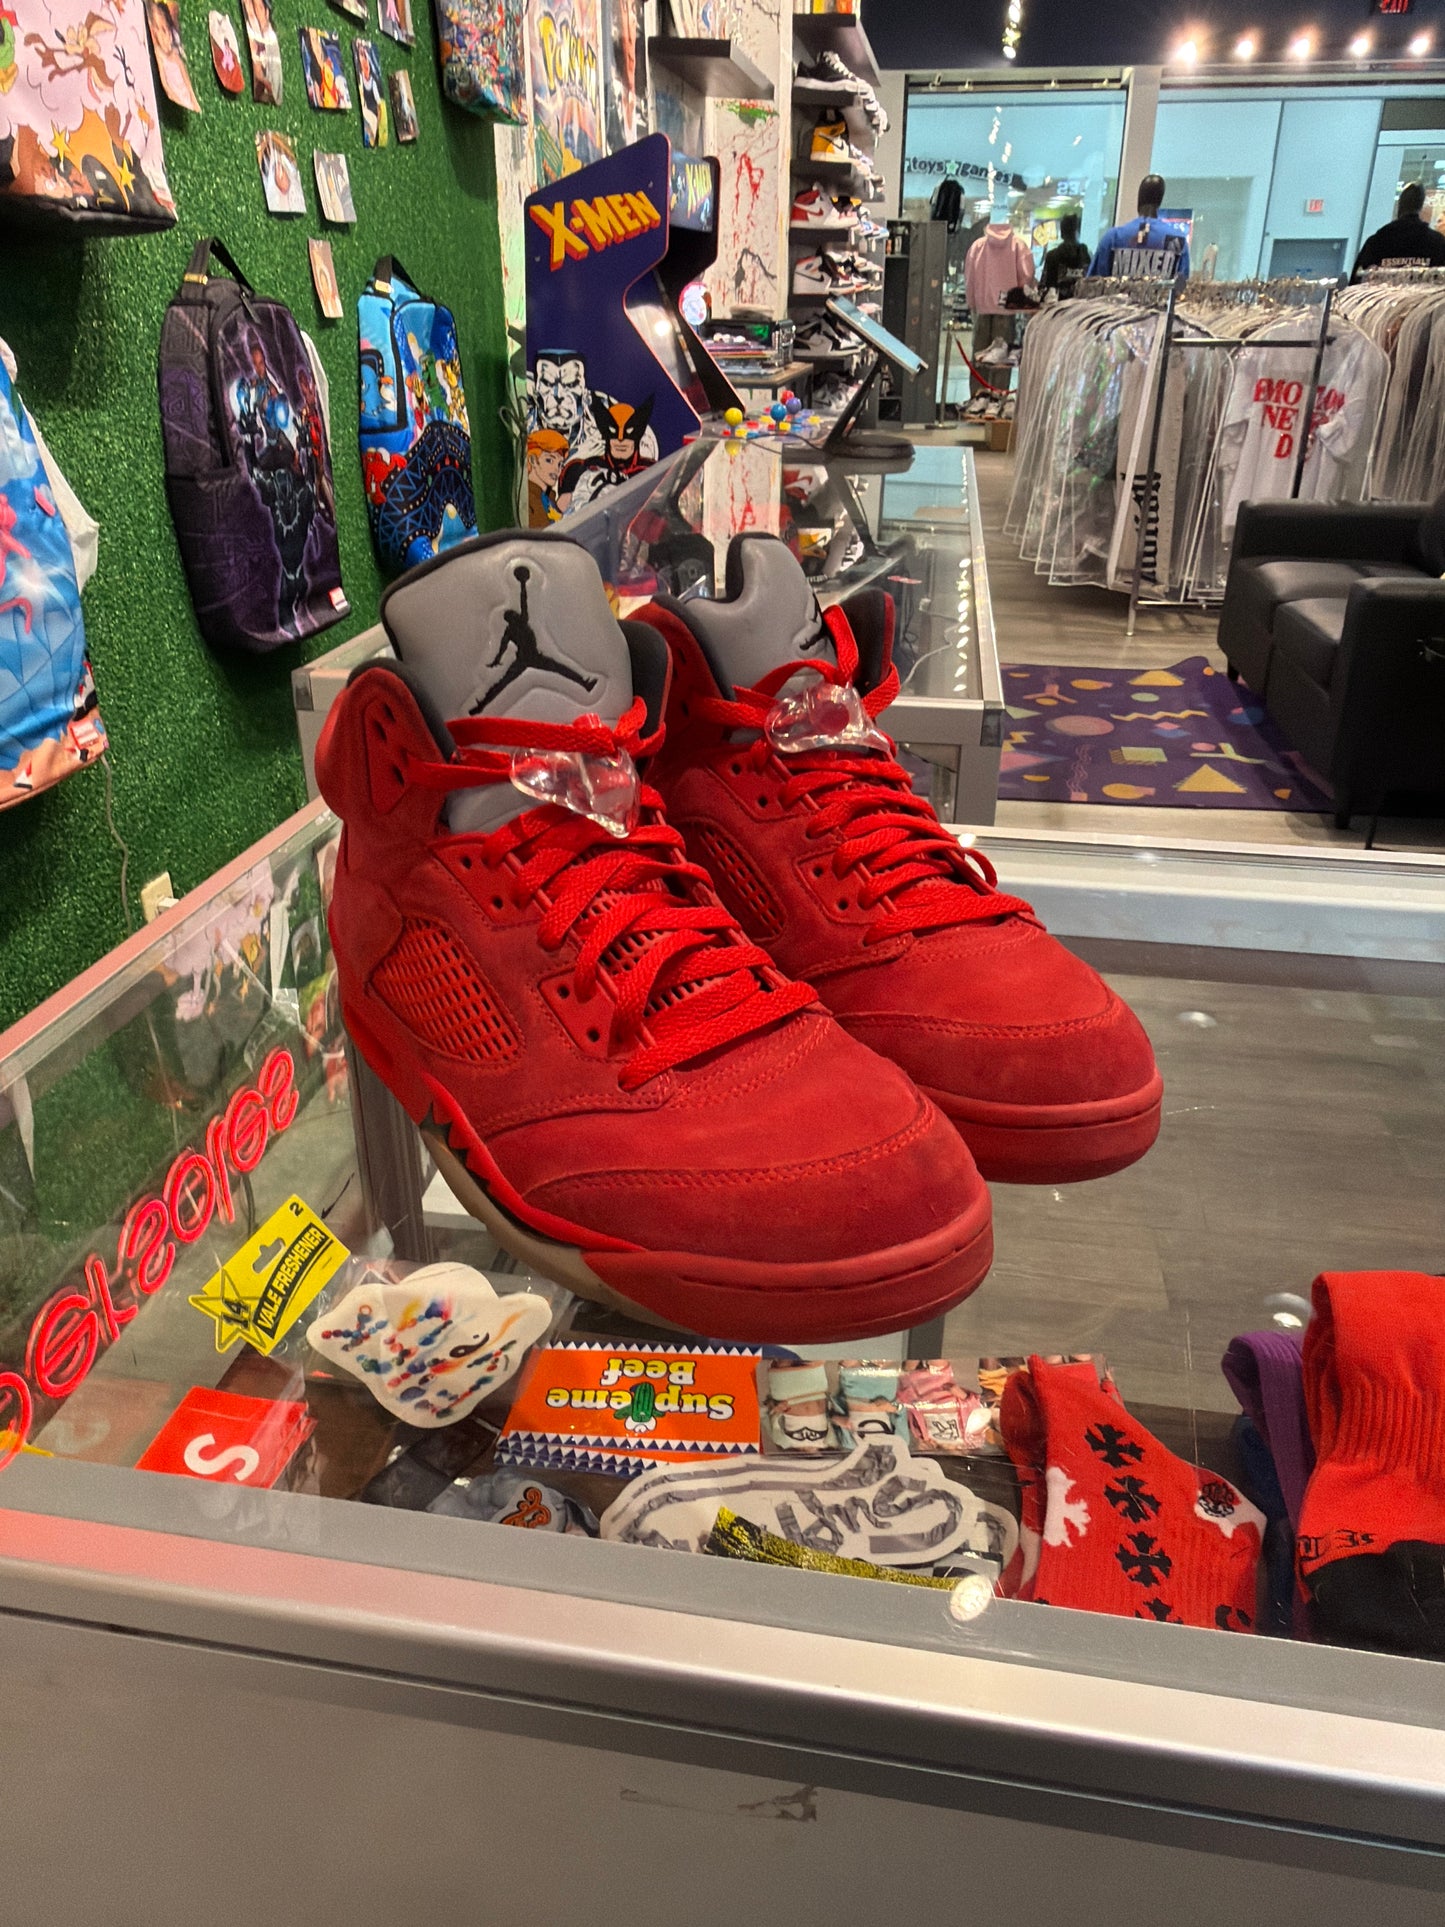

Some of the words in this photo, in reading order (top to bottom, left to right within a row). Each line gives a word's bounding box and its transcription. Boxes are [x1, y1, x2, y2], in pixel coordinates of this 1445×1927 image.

[912, 157, 944, 174] toys
[529, 191, 661, 272] X-MEN
[1112, 248, 1176, 278] MIXED
[1381, 257, 1431, 267] ESSENTIALS
[289, 1202, 304, 1216] 2
[257, 1289, 281, 1329] VALE
[272, 1227, 325, 1294] FRESHENER
[600, 1358, 696, 1386] Beef
[184, 1432, 260, 1481] S
